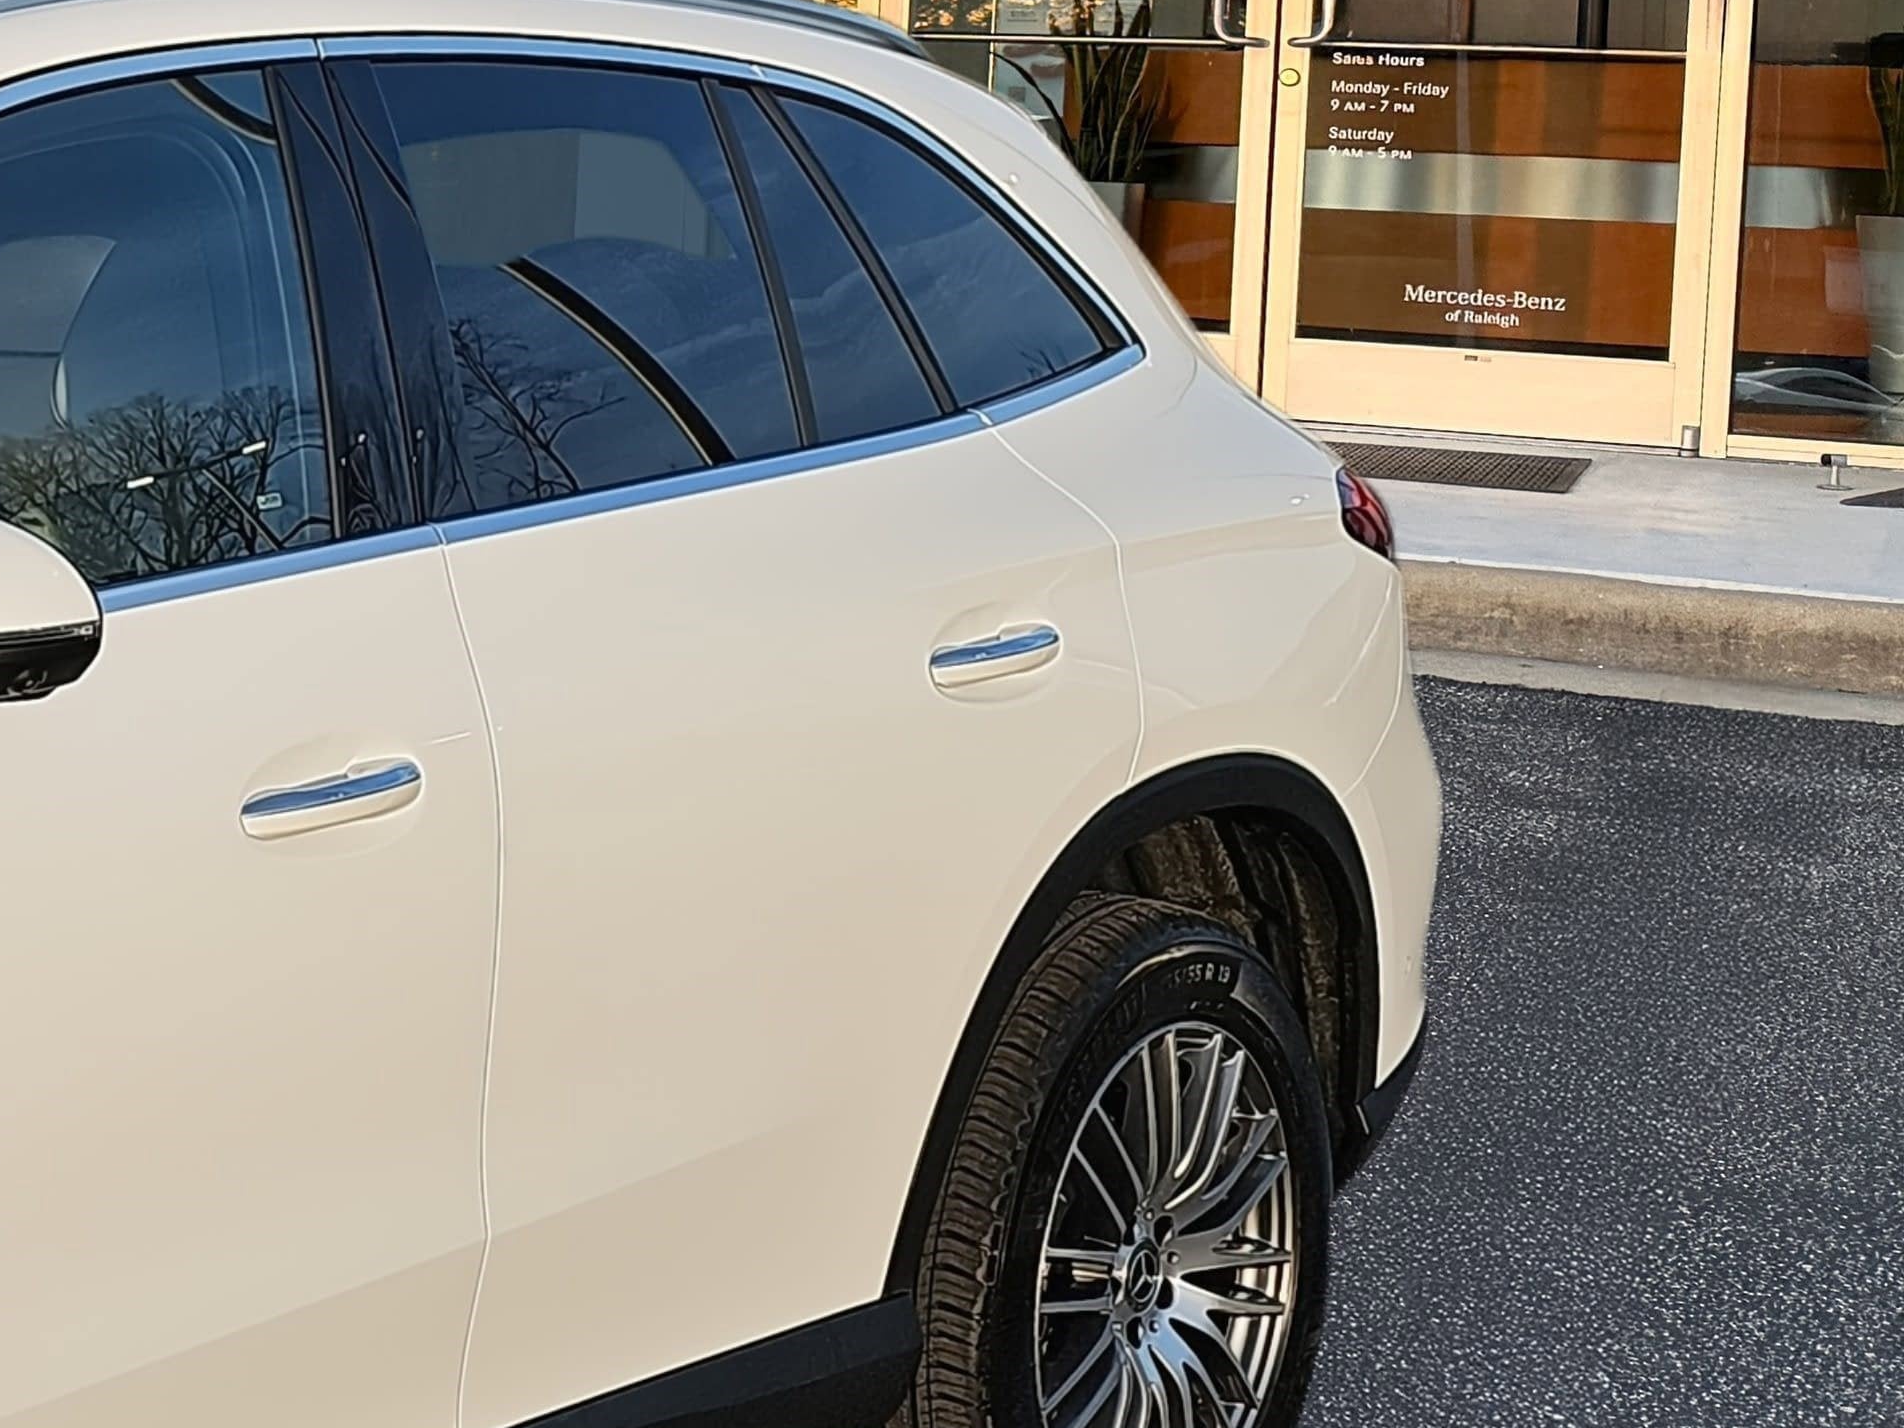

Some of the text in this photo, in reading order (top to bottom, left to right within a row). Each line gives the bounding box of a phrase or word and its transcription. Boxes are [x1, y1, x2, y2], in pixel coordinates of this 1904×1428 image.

[1378, 53, 1425, 67] Hours
[1331, 80, 1390, 97] Monday
[1403, 82, 1449, 98] Friday
[1330, 99, 1340, 111] 9
[1344, 102, 1366, 112] AM
[1379, 100, 1389, 112] 7
[1393, 103, 1415, 114] PM
[1328, 126, 1394, 144] Saturday
[1328, 146, 1338, 157] 9
[1342, 149, 1364, 159] AM
[1378, 147, 1386, 159] 5
[1391, 150, 1412, 160] PM
[1404, 284, 1566, 312] Mercedes-Benz
[1445, 310, 1520, 328] of Raleigh
